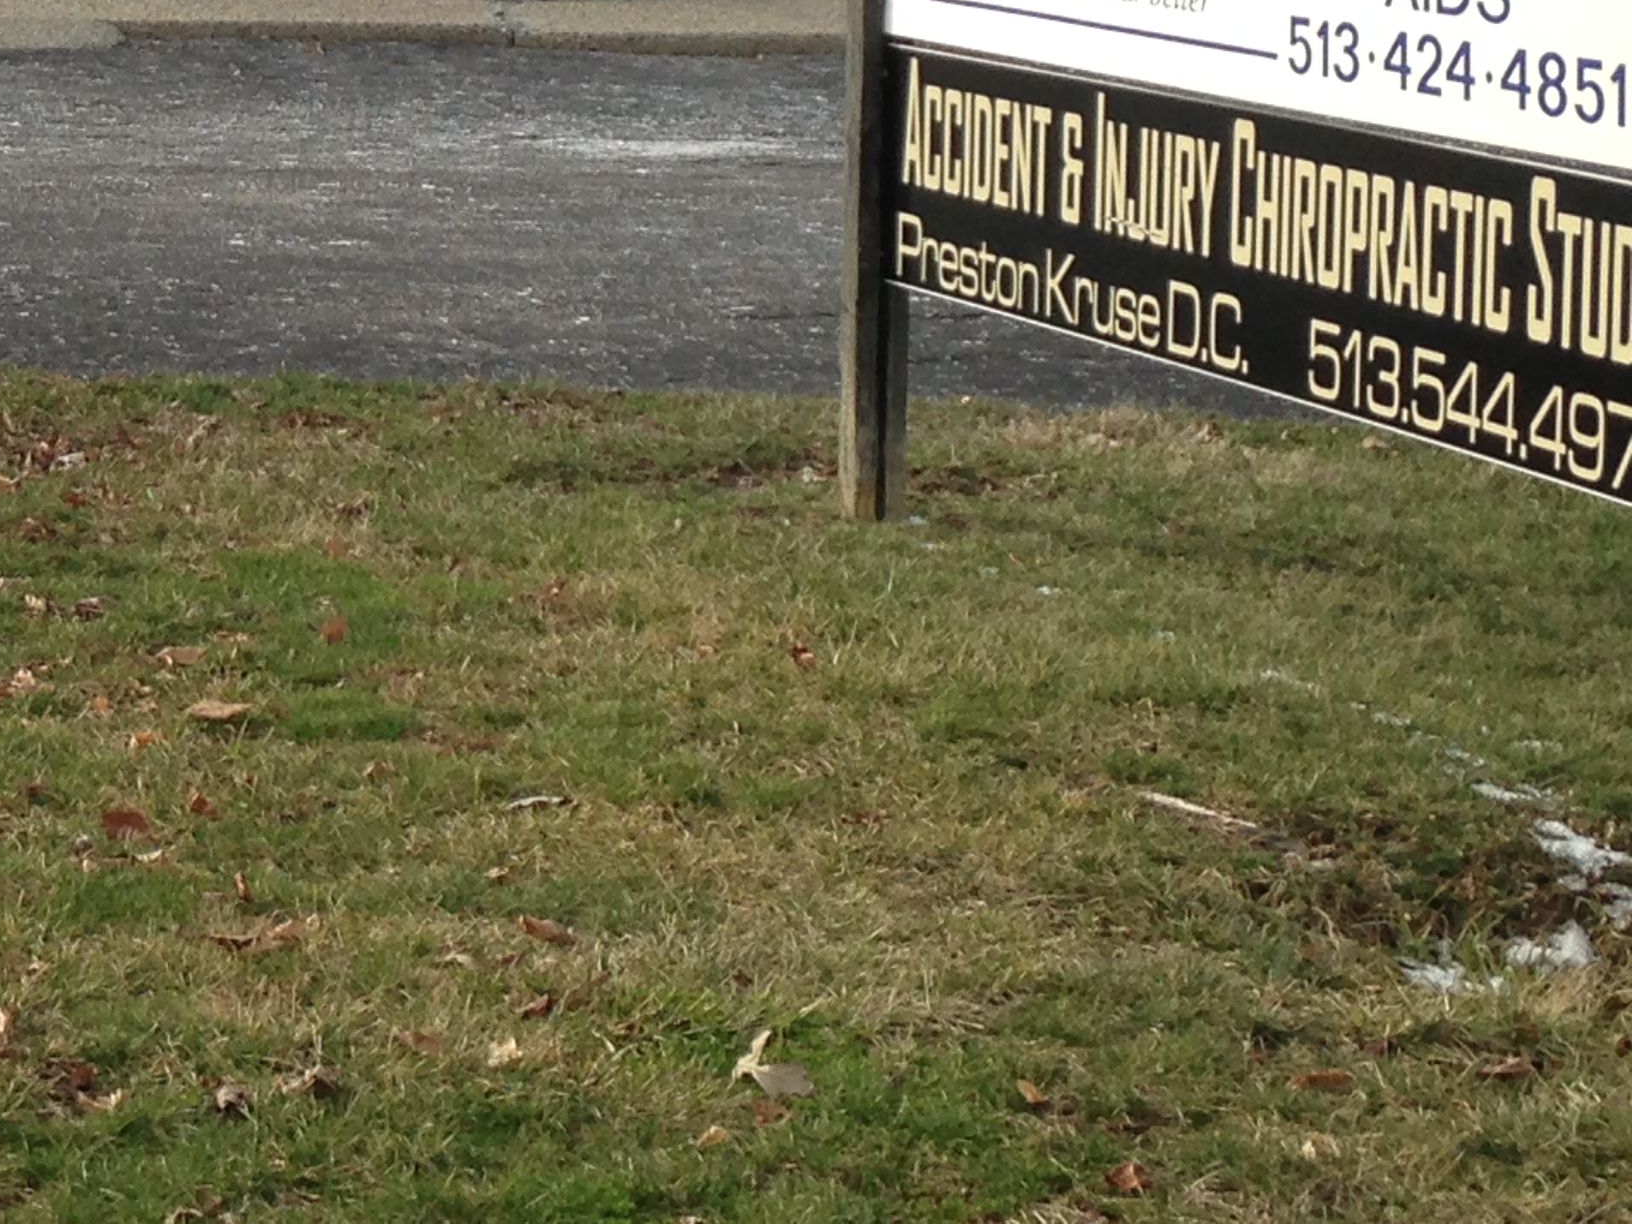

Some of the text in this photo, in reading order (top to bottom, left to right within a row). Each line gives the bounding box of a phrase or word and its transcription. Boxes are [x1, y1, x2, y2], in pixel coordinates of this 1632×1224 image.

[901, 56, 1052, 218] ACCIDENT
[1060, 110, 1084, 225] &
[1094, 91, 1220, 258] INJURY
[1230, 118, 1513, 333] CHIROPRACTIC
[1167, 278, 1249, 375] D.C.
